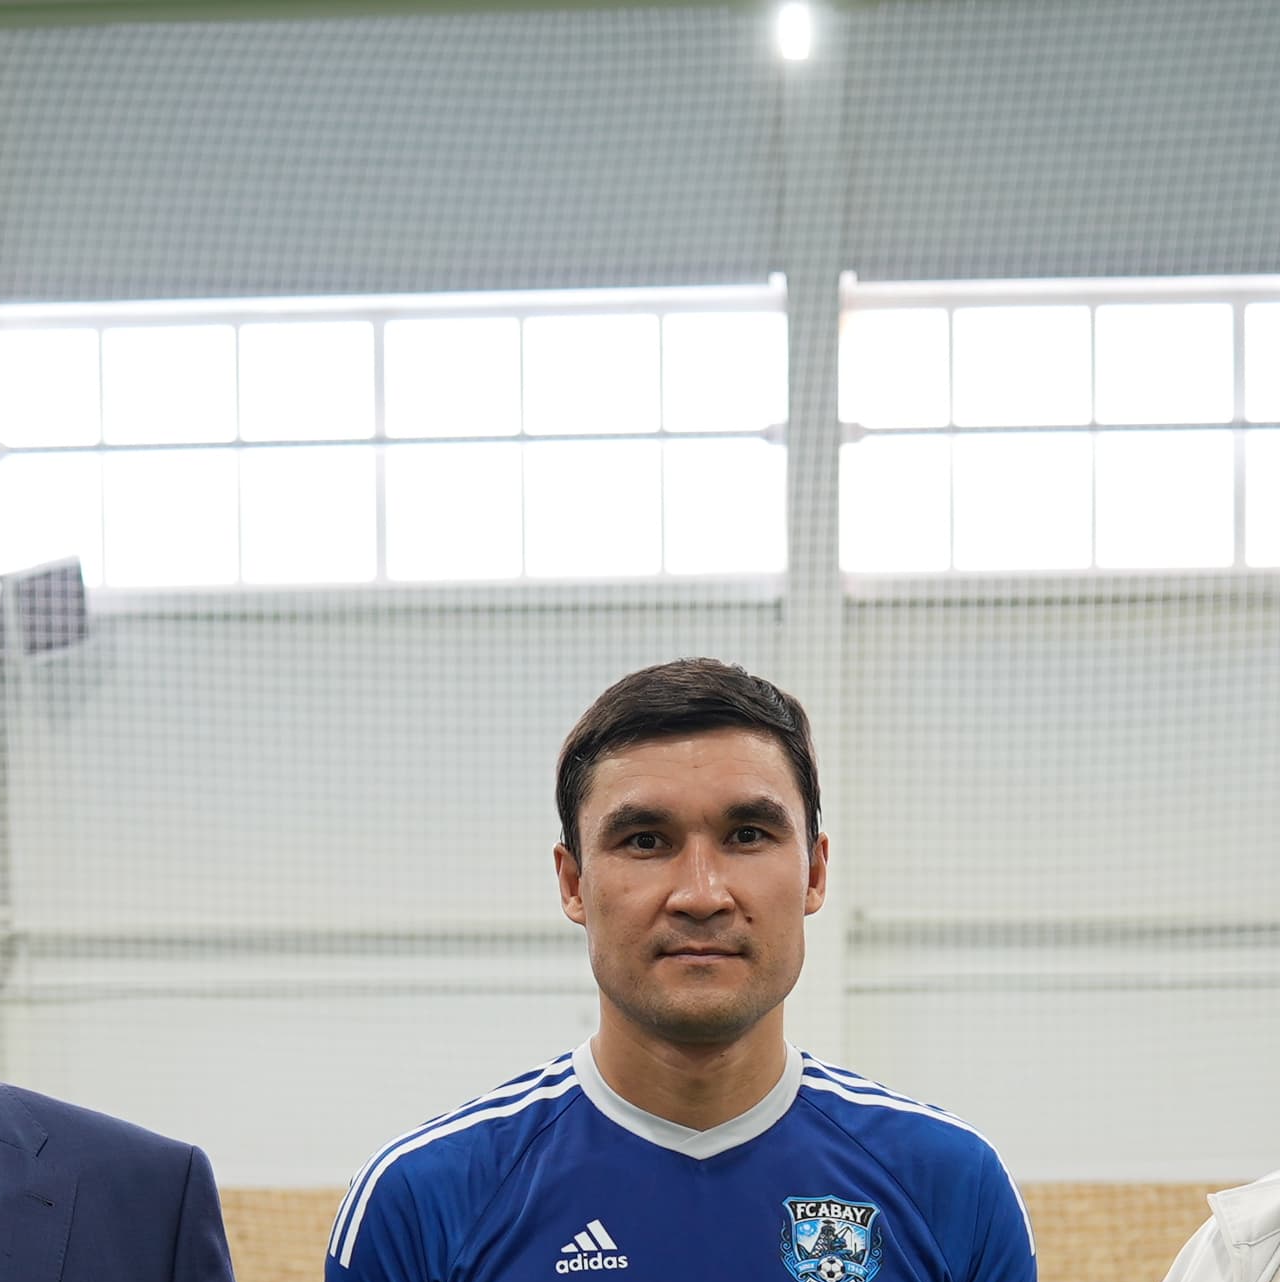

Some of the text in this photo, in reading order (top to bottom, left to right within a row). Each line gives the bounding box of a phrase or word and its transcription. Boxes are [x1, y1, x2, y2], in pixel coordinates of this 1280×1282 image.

[796, 1202, 866, 1224] FC ABAY
[555, 1251, 629, 1274] adidas
